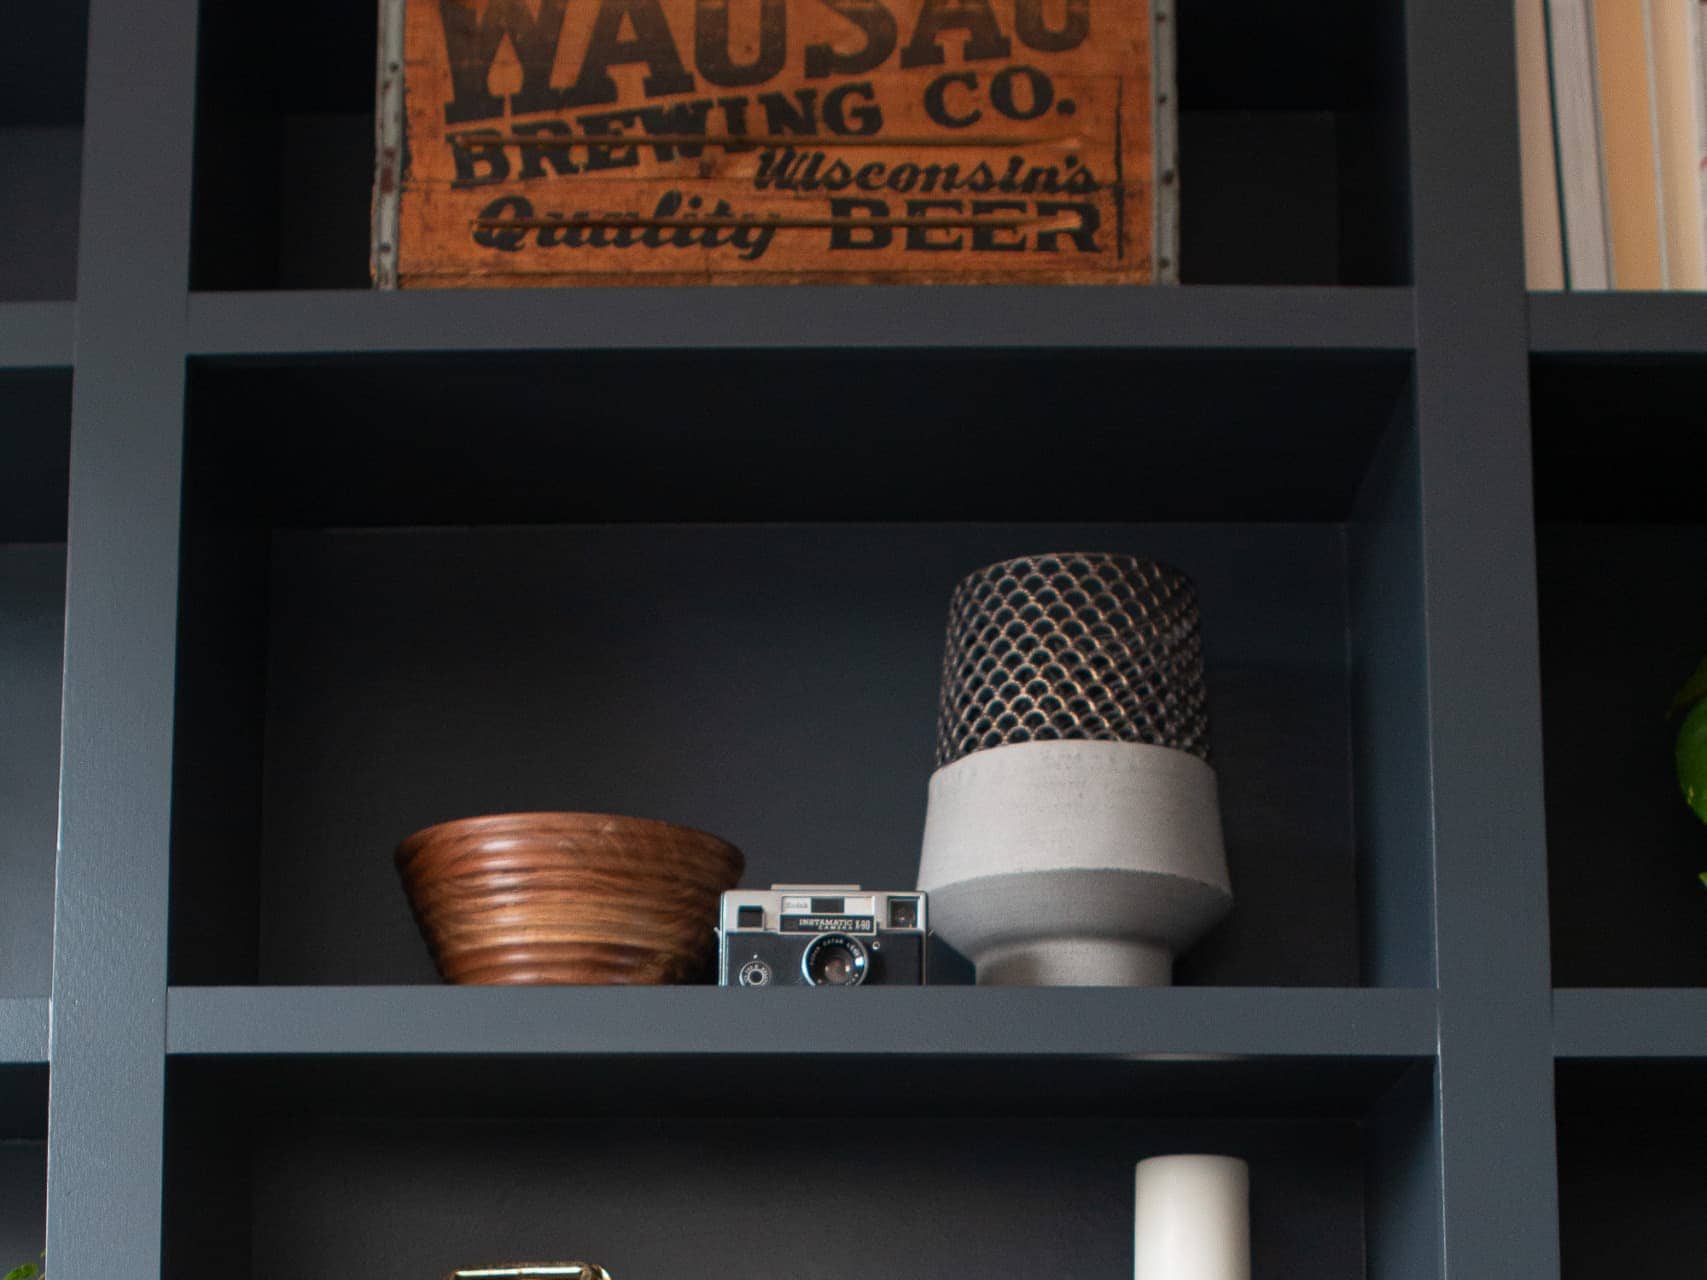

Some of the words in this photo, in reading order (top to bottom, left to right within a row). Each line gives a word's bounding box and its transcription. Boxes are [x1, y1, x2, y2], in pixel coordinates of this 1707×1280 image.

[445, 82, 884, 190] BREWING
[923, 65, 1077, 129] CO.
[754, 146, 1099, 195] Wisconsin's
[471, 190, 780, 262] Quality
[828, 197, 1102, 253] BEER
